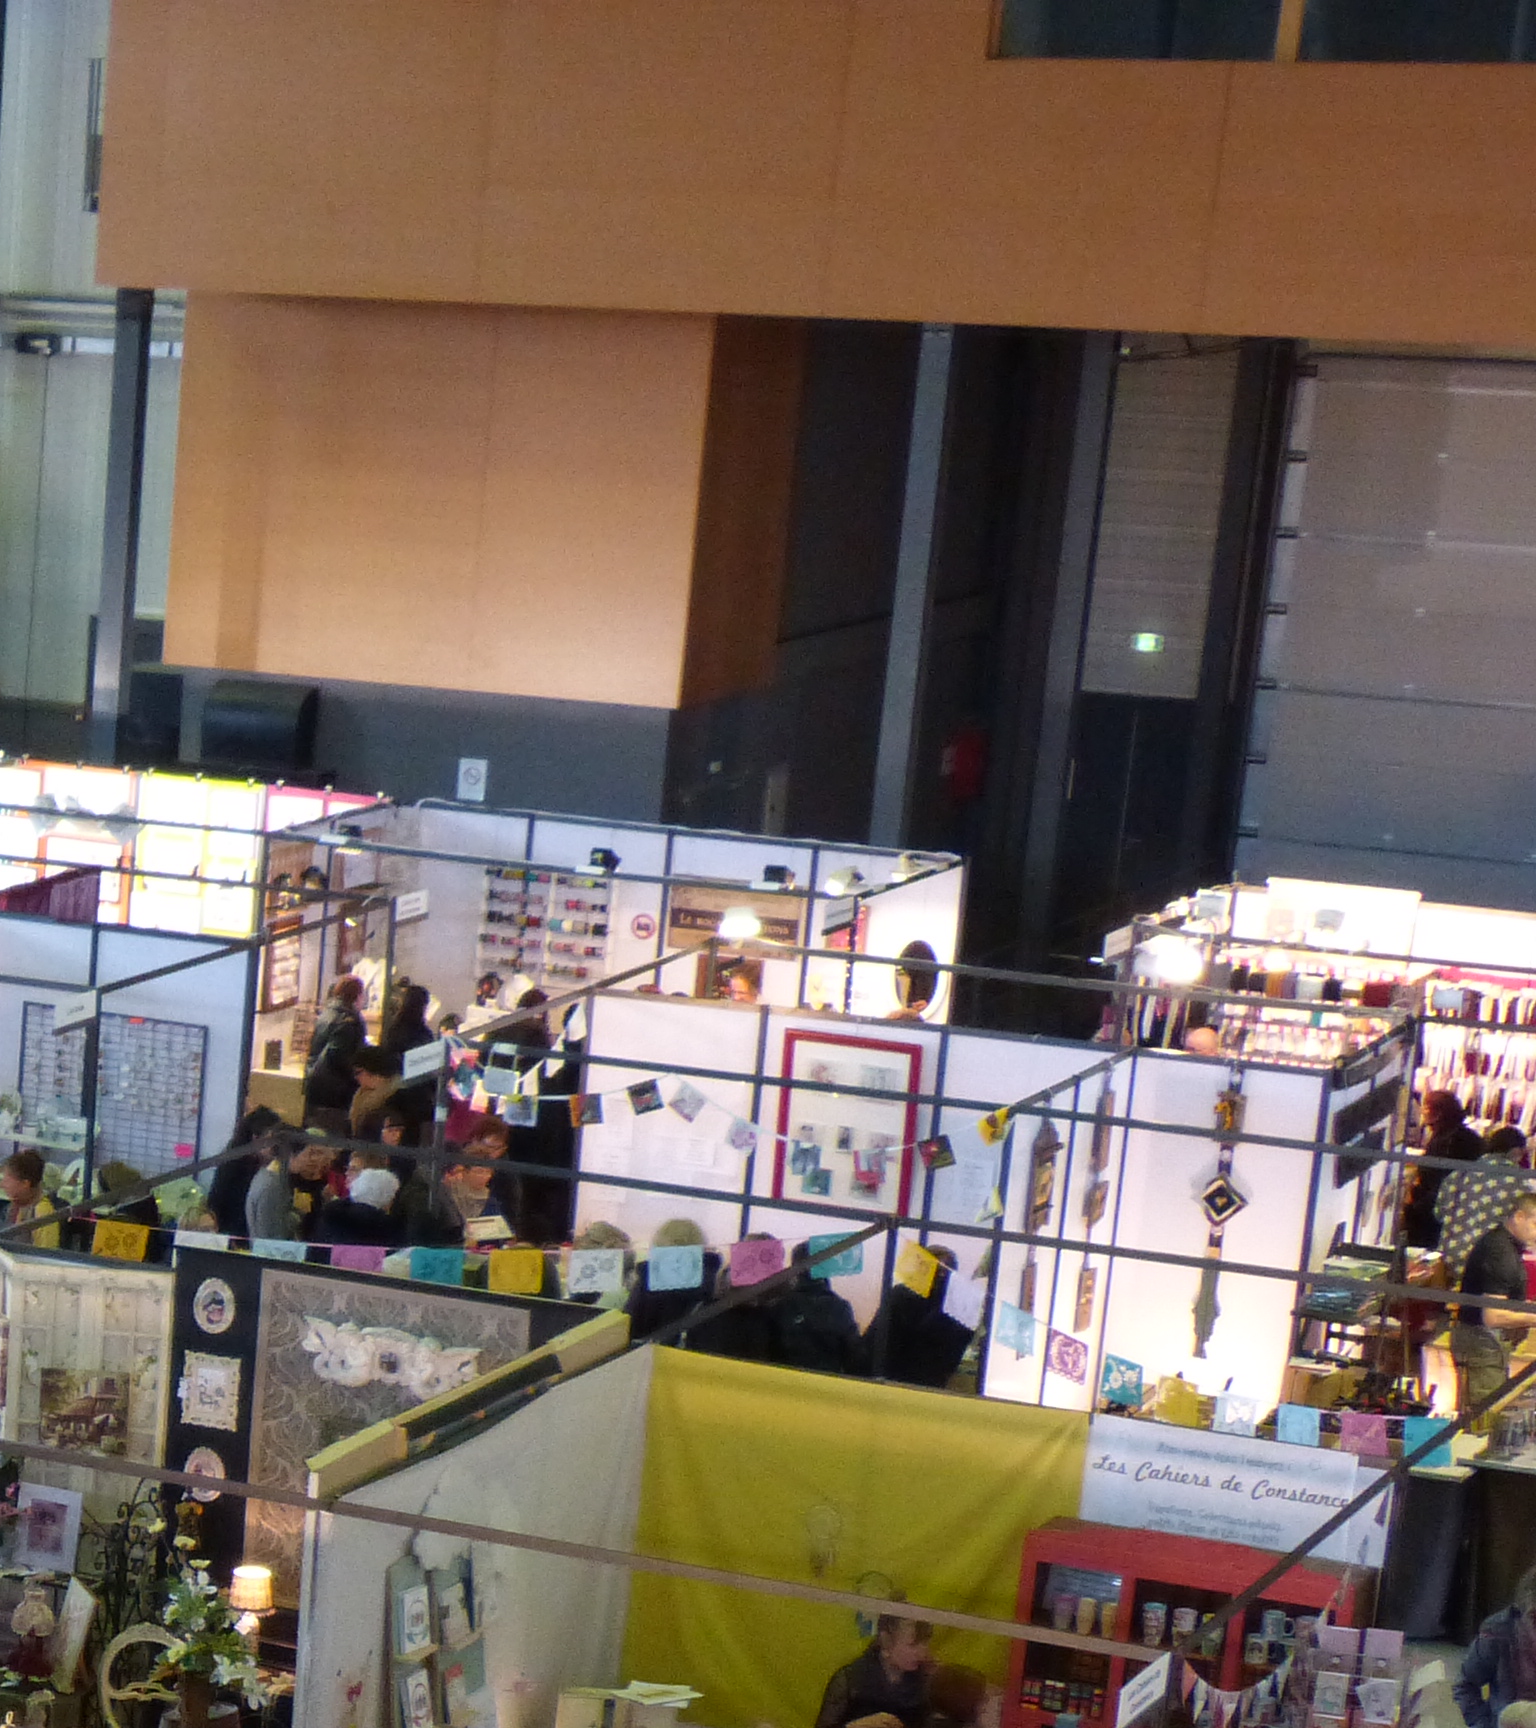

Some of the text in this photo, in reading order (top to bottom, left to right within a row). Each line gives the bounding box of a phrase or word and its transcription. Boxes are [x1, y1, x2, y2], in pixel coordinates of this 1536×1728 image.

[1092, 1453, 1350, 1509] Les Cahiers de Constance
